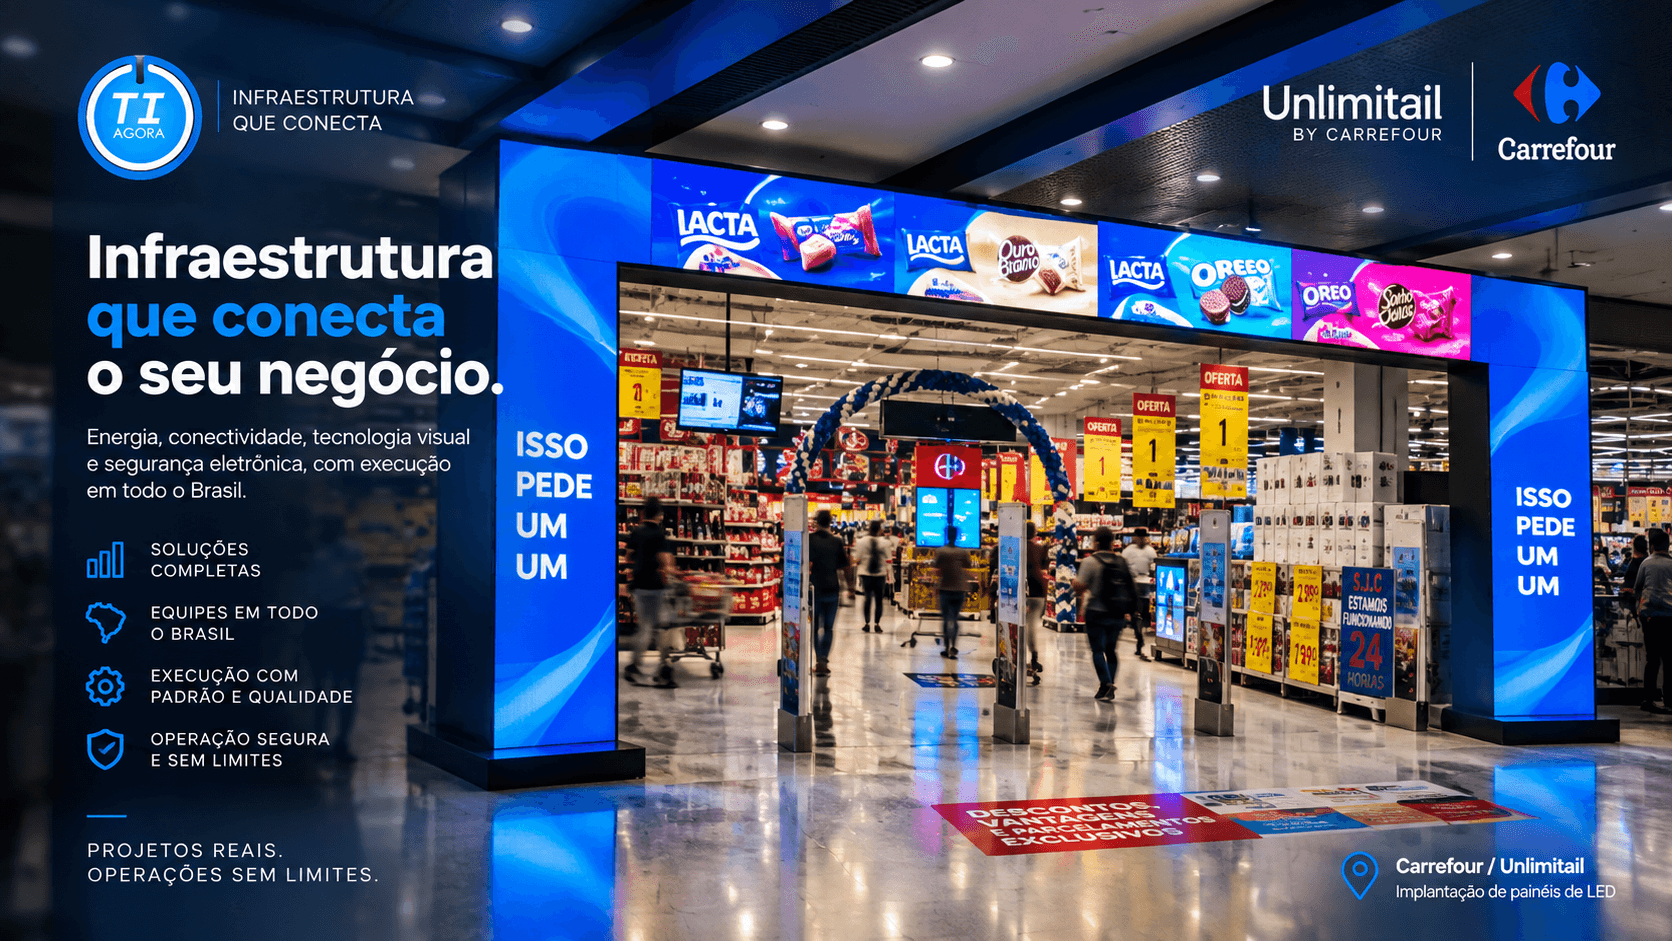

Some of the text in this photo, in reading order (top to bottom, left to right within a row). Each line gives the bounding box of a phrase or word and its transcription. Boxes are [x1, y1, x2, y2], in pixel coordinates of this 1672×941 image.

[677, 208, 759, 237] LACTA
[907, 233, 963, 255] LACTA
[998, 239, 1035, 260] Ouro
[1109, 259, 1165, 280] LACTA
[1303, 284, 1352, 306] OREO
[1204, 371, 1243, 386] OFERTA
[1218, 418, 1227, 446] 1
[515, 430, 589, 460] ISSO
[1149, 438, 1157, 463] 1
[1099, 456, 1105, 476] 1
[515, 470, 593, 500] PEDE
[1516, 487, 1572, 508] ISSO
[515, 512, 568, 539] UM
[1516, 516, 1575, 537] PEDE
[515, 553, 568, 580] UM
[1517, 546, 1558, 566] UM
[1517, 576, 1559, 596] UM
[1349, 631, 1383, 671] 24
[977, 810, 1156, 828] VANTAGENS
[1012, 816, 1216, 836] PARCELAMENTOS
[990, 828, 1010, 837] E
[1001, 827, 1184, 847] EXCLUSIVOS
